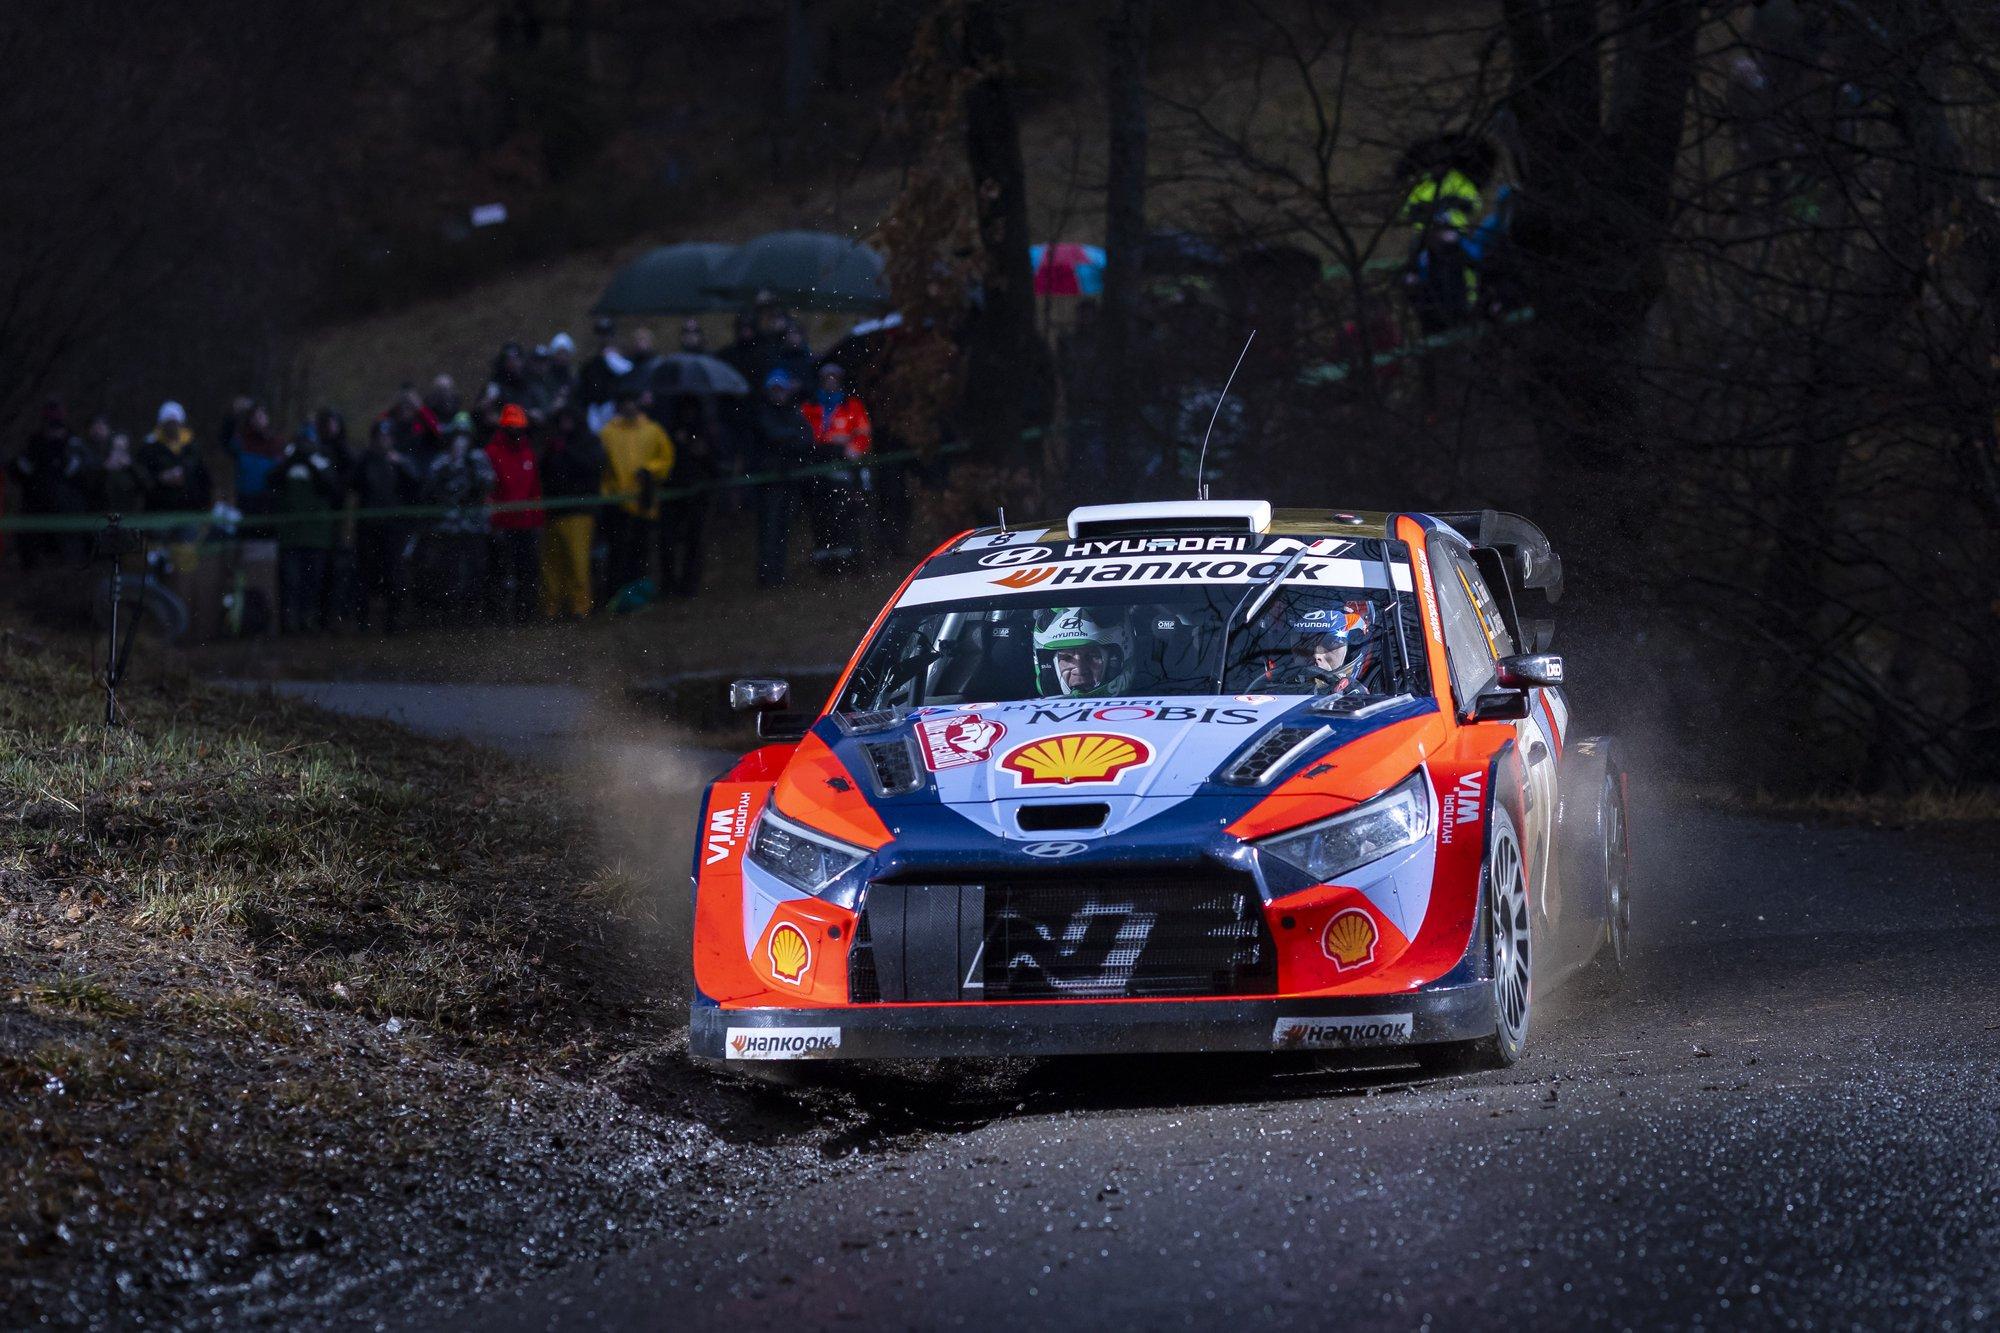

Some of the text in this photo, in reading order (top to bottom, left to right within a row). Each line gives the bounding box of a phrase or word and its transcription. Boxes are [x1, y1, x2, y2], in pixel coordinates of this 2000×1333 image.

[1065, 538, 1246, 557] HYUNDAI
[1003, 700, 1164, 711] HYUNDAI
[1026, 706, 1258, 725] MOBIS
[733, 792, 751, 837] HYUNDAI
[1442, 795, 1455, 844] HYUNDAI
